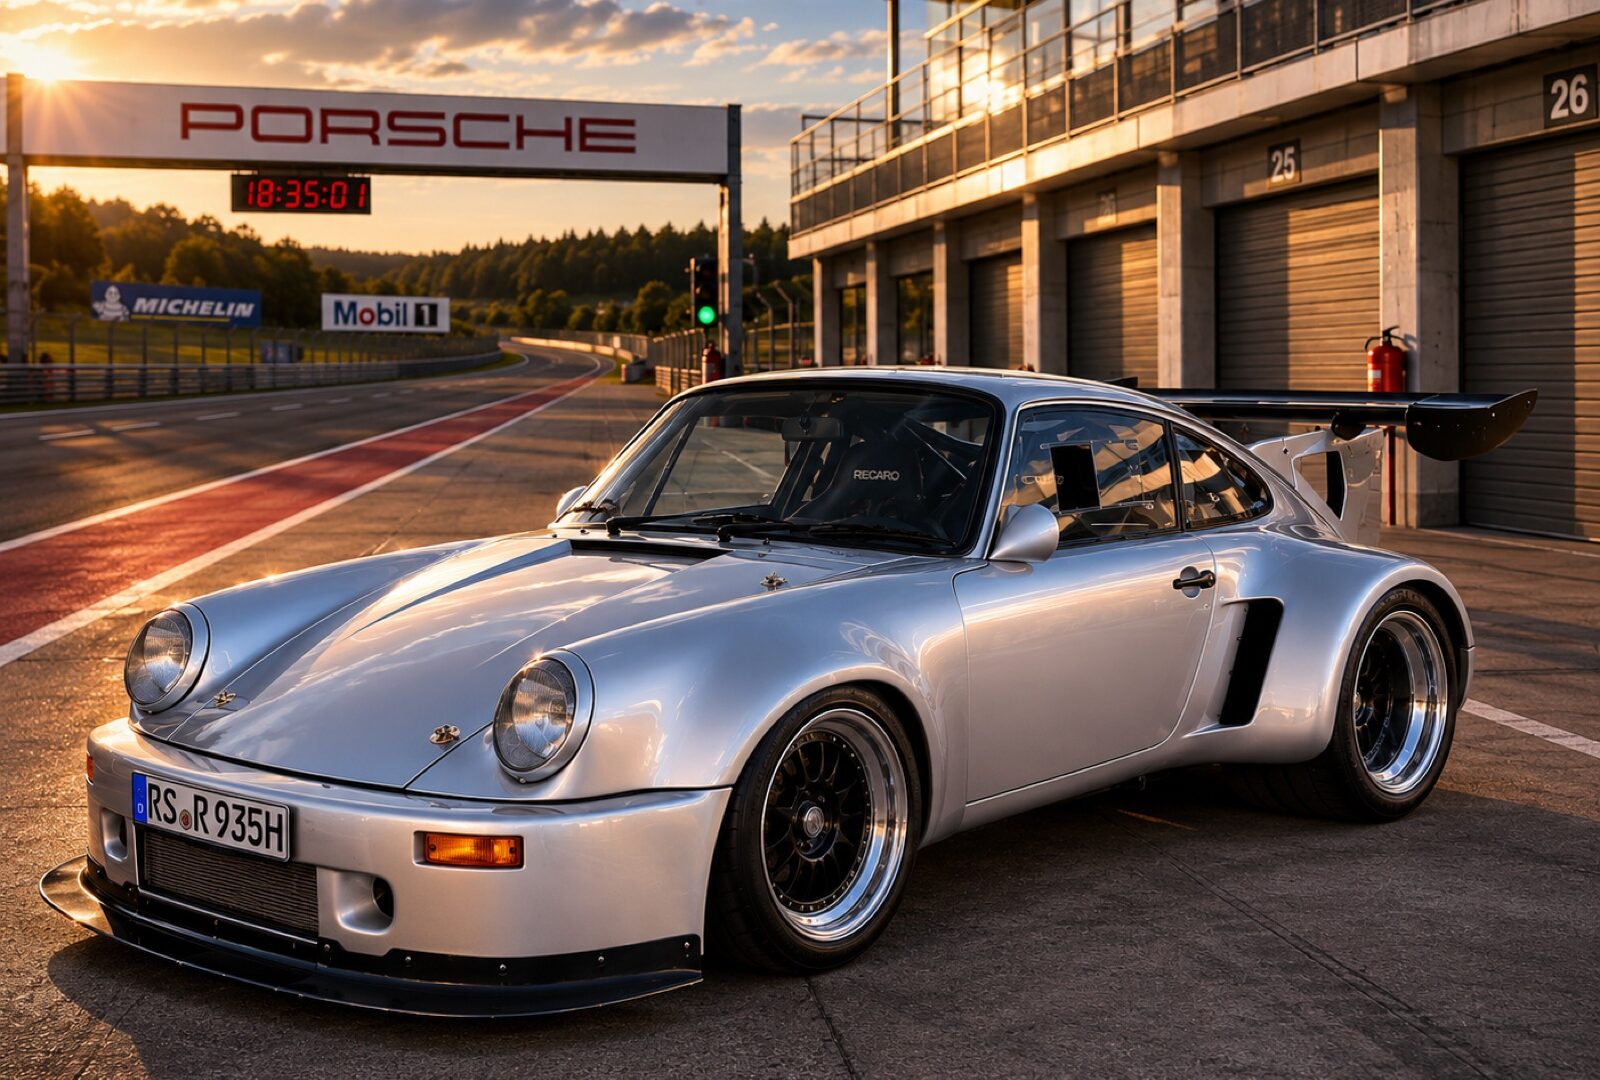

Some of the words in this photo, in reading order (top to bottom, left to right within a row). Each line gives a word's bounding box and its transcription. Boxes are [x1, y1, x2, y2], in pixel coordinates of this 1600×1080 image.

[1551, 74, 1588, 119] 26
[180, 102, 637, 153] PORSCHE
[1271, 146, 1295, 182] 25
[247, 179, 366, 209] 18:35:01
[133, 297, 255, 317] MICHELIN
[333, 301, 408, 327] Mobil
[853, 469, 900, 481] RECARO
[137, 803, 144, 814] D
[147, 783, 178, 825] RS
[193, 794, 210, 834] R
[214, 800, 284, 852] 935H
